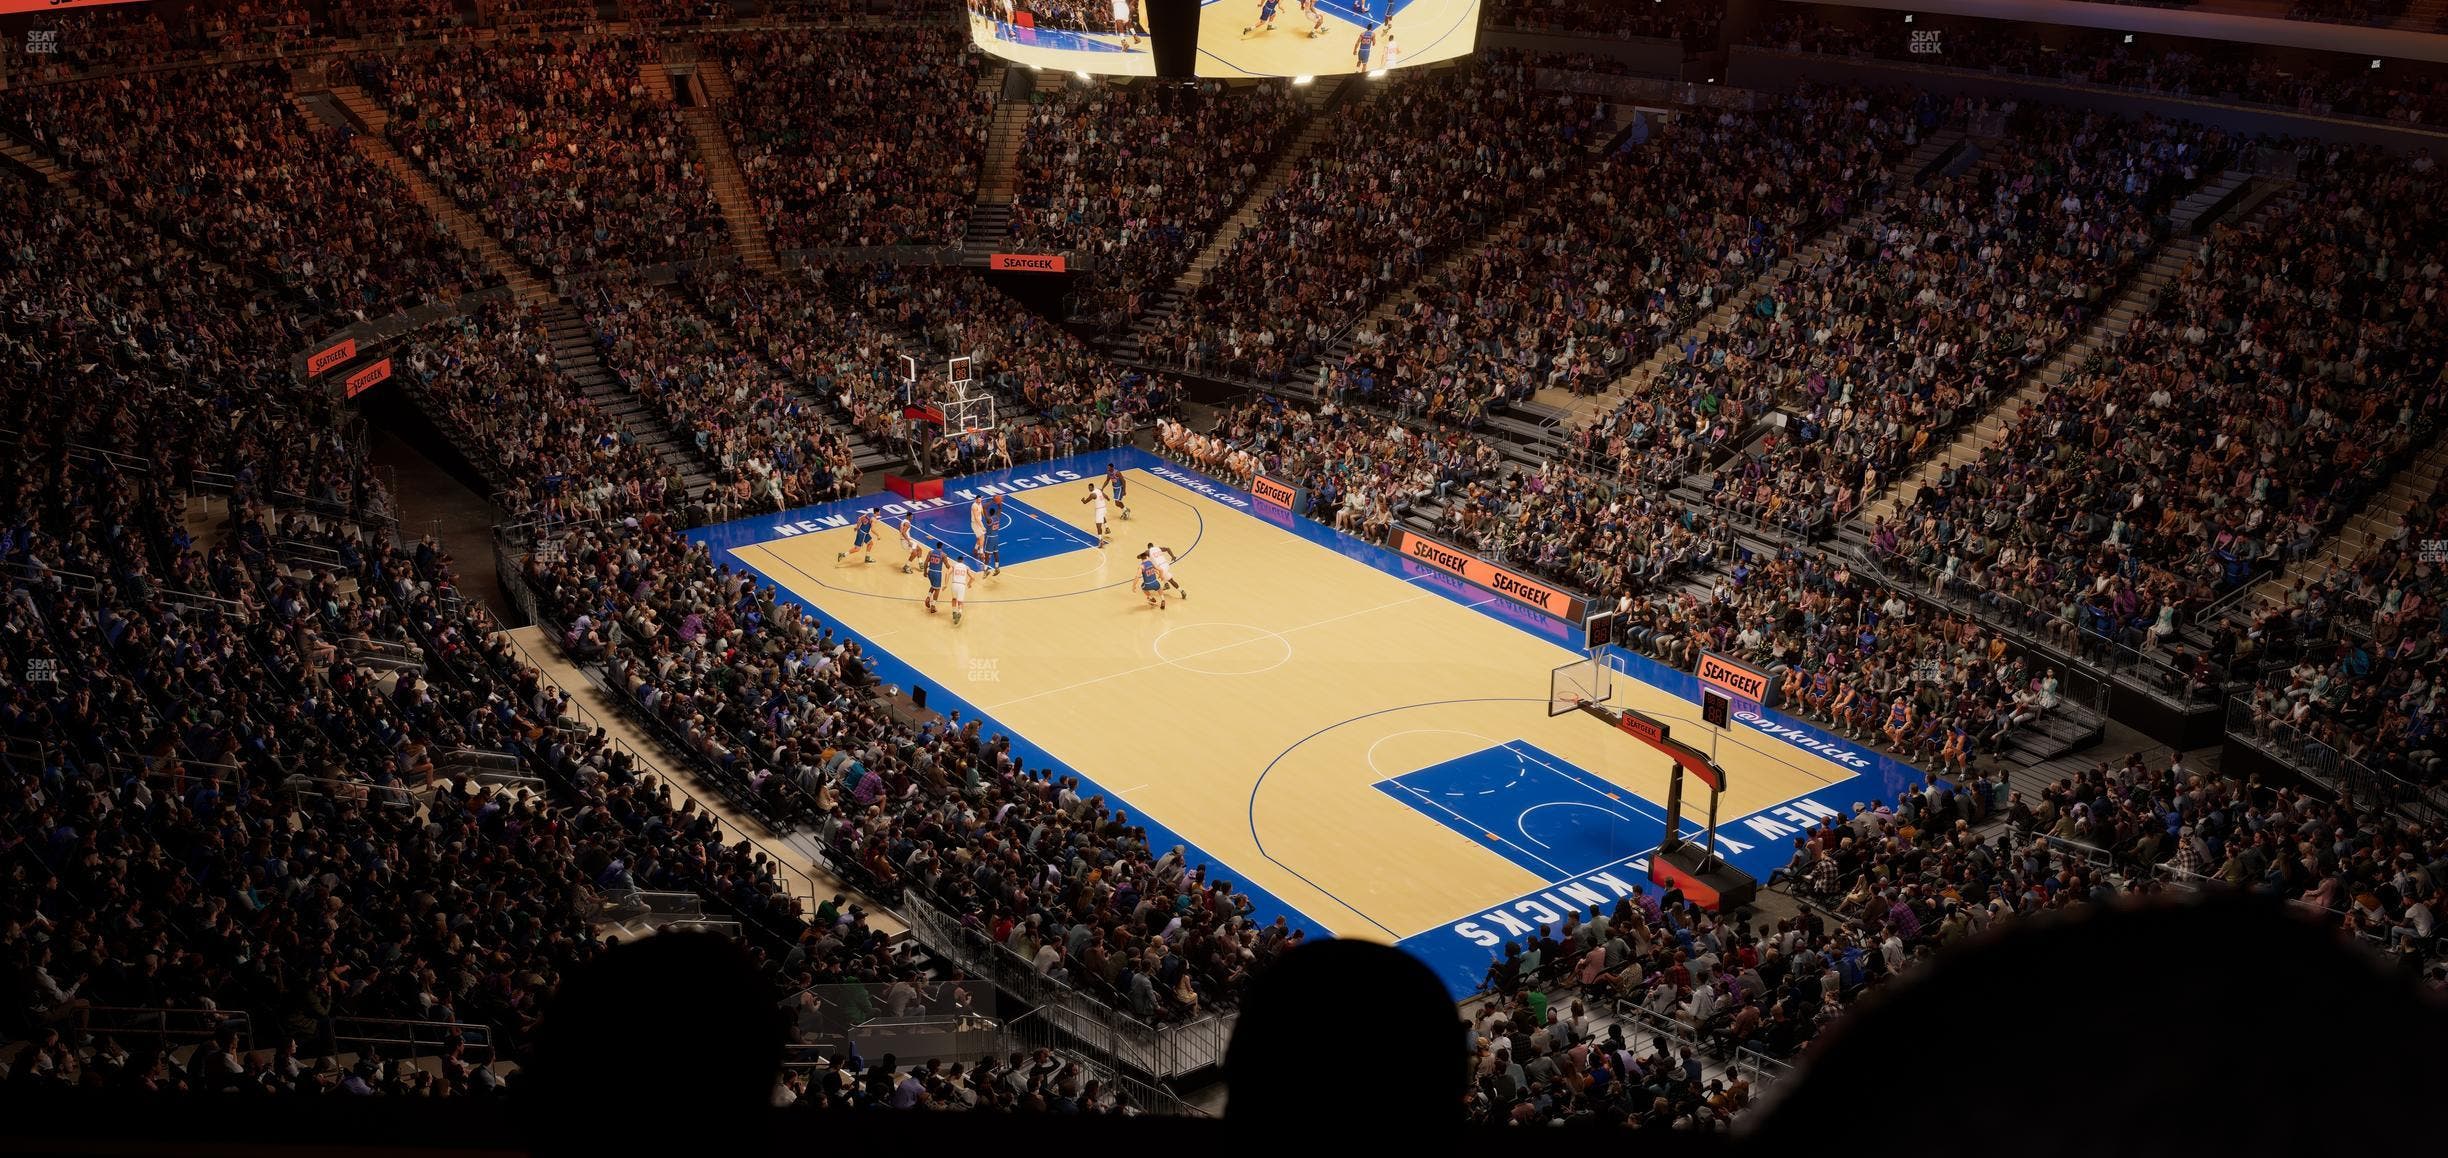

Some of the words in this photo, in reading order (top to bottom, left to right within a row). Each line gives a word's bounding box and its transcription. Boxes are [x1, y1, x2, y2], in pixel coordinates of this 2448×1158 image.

[1003, 258, 1053, 270] SEATGEEK
[315, 346, 348, 371] SEATGEEK
[352, 366, 384, 394] SEATGEEK
[772, 513, 851, 537] NEW
[954, 470, 1081, 501] KNICKS
[1150, 466, 1249, 508] nyknicks.com
[1255, 480, 1293, 507] SEATGEEK
[1413, 540, 1469, 576] SEATGEEK
[1492, 572, 1552, 610] SEATGEEK
[1703, 661, 1763, 699] SEATGEEK
[1626, 717, 1657, 739] SEATGEEK
[1733, 710, 1871, 768] @nyknicks
[1742, 798, 1840, 840] NEW
[1454, 871, 1634, 947] KNICKS
